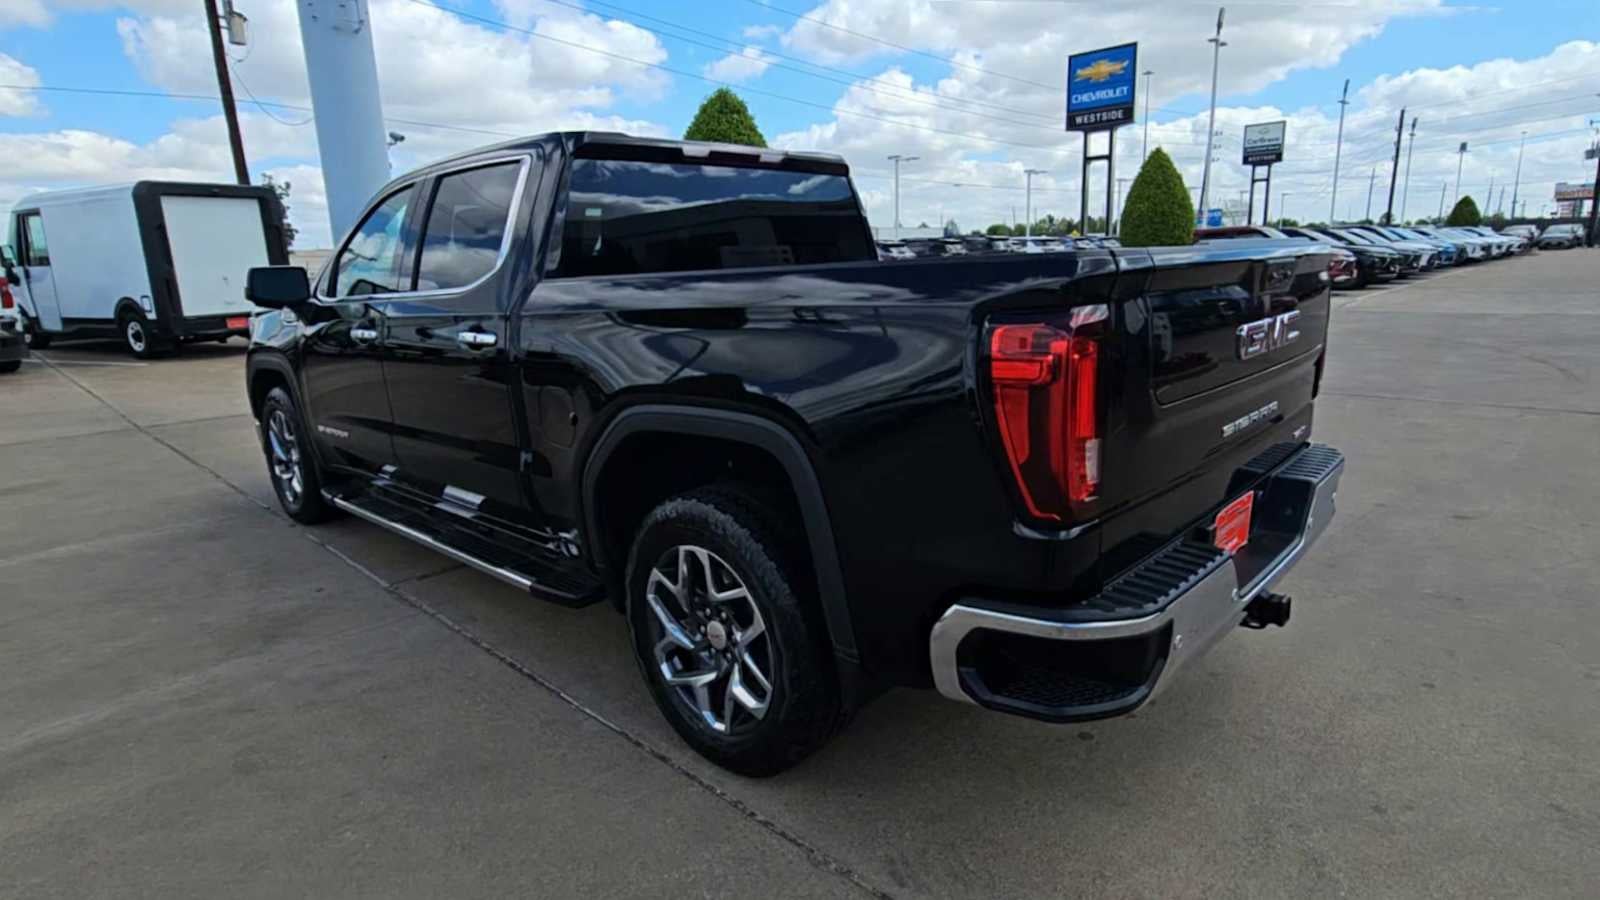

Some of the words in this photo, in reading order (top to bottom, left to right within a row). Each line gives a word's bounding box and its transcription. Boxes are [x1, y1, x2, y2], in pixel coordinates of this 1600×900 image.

[1072, 86, 1128, 104] CHEVROLET
[1075, 109, 1124, 124] WESTSIDE
[1236, 310, 1300, 360] GMC
